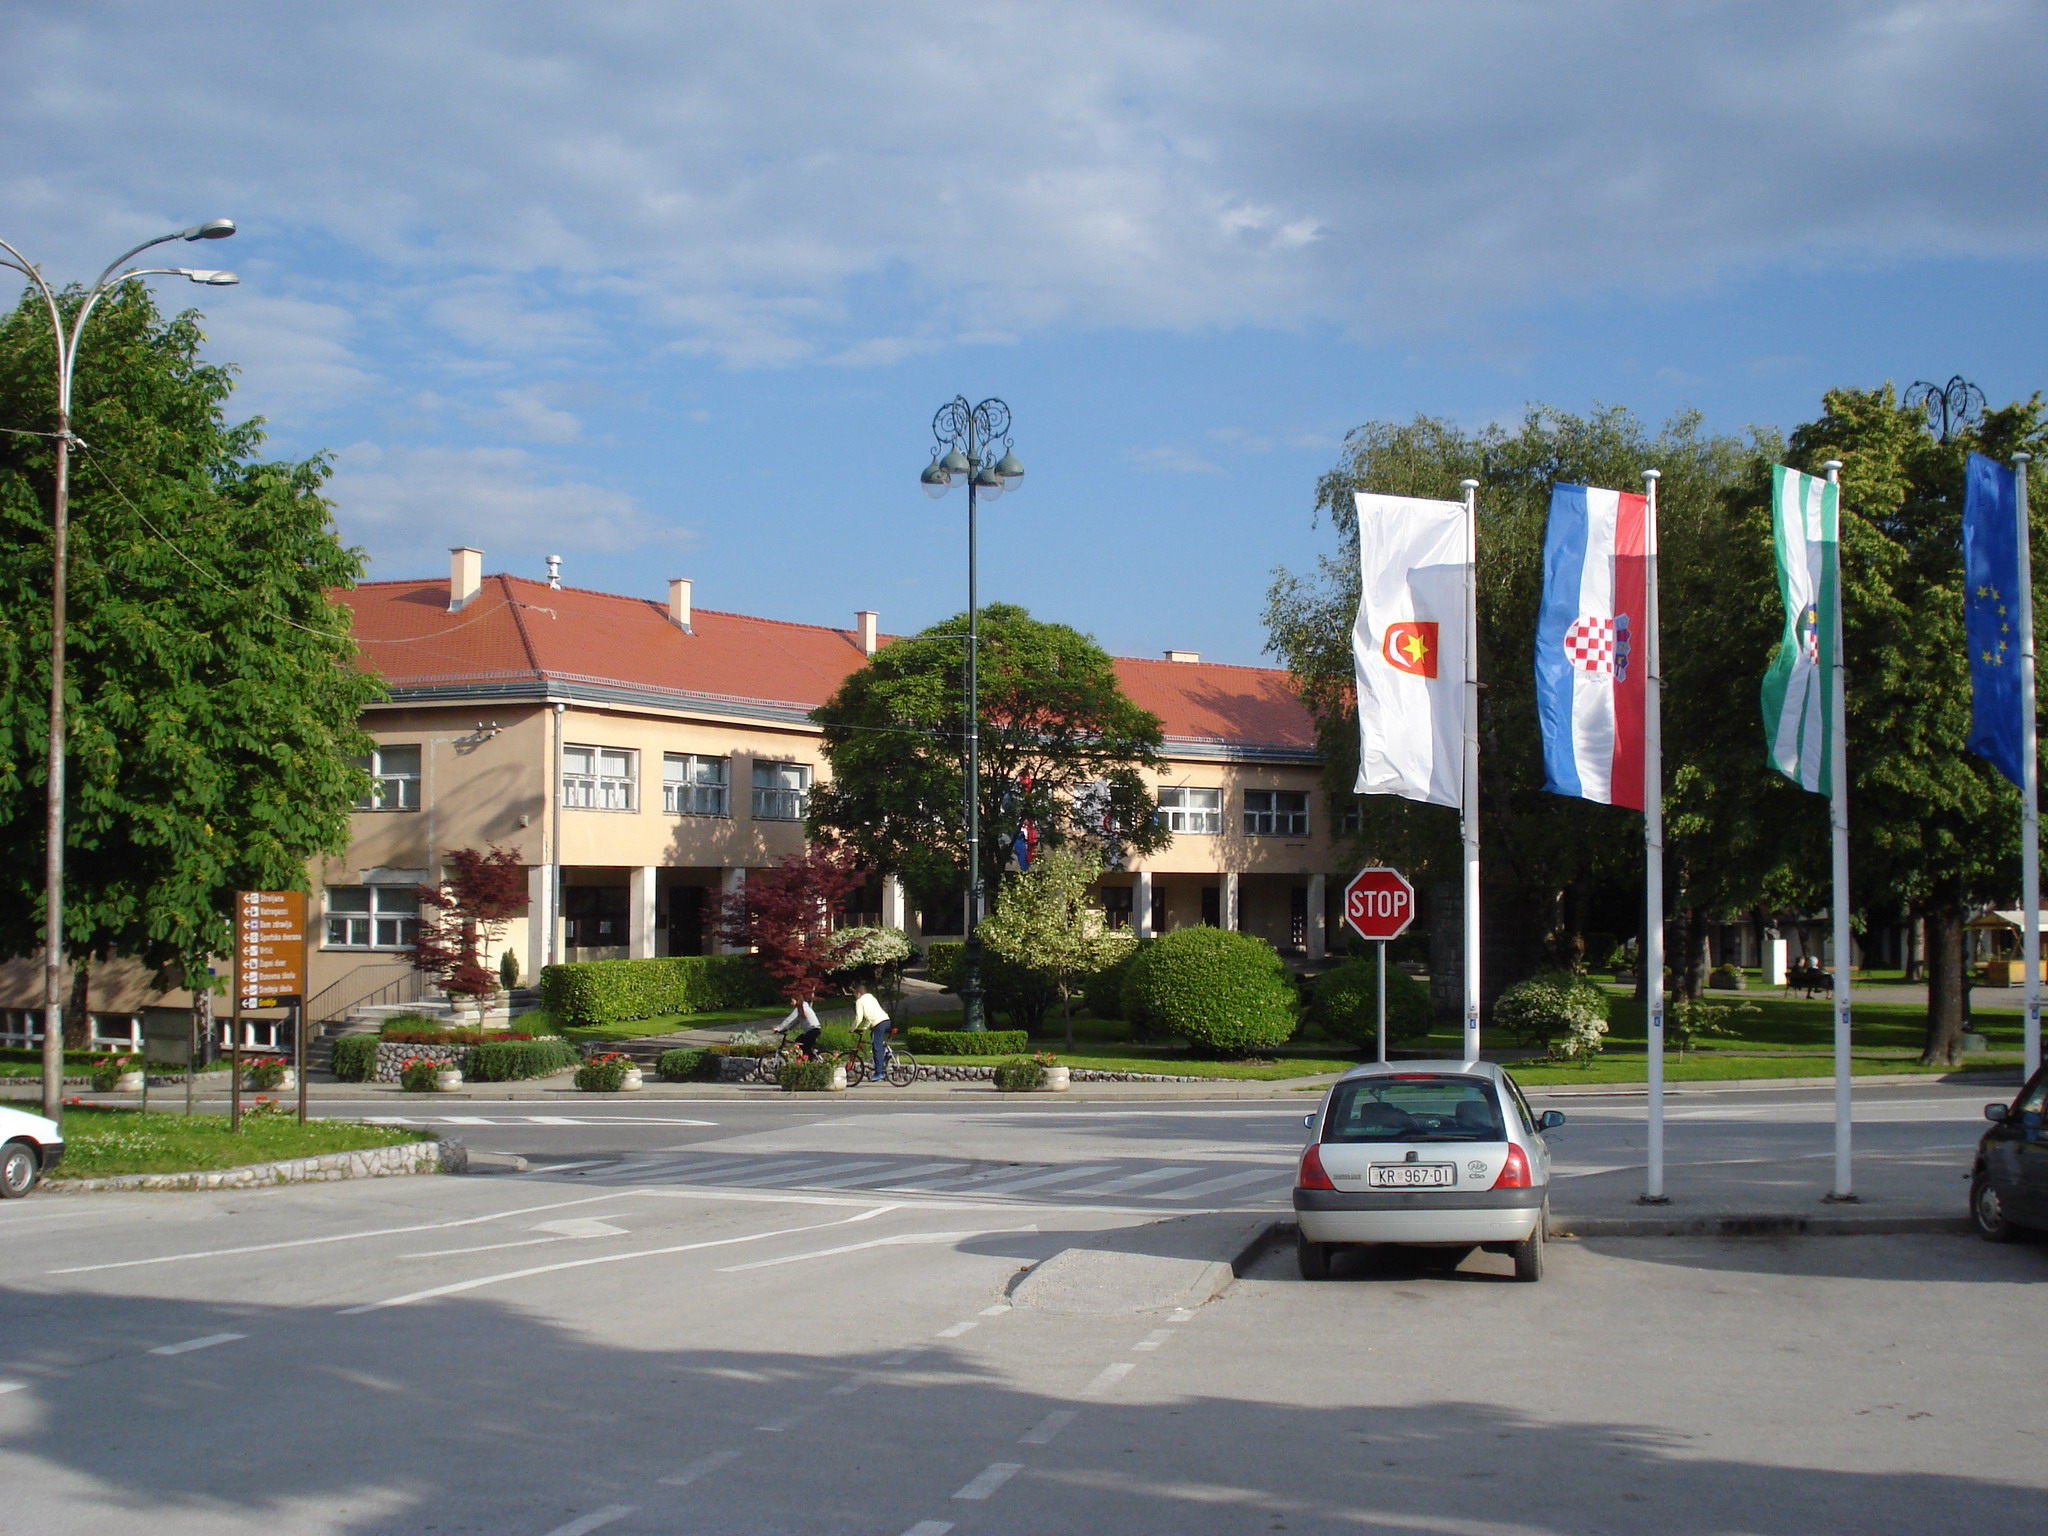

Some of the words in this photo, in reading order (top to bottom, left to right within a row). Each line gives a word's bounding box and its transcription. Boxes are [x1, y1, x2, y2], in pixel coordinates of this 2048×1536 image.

[1350, 891, 1408, 918] STOP
[1379, 1169, 1395, 1183] KR
[1405, 1169, 1448, 1183] 967-DI
